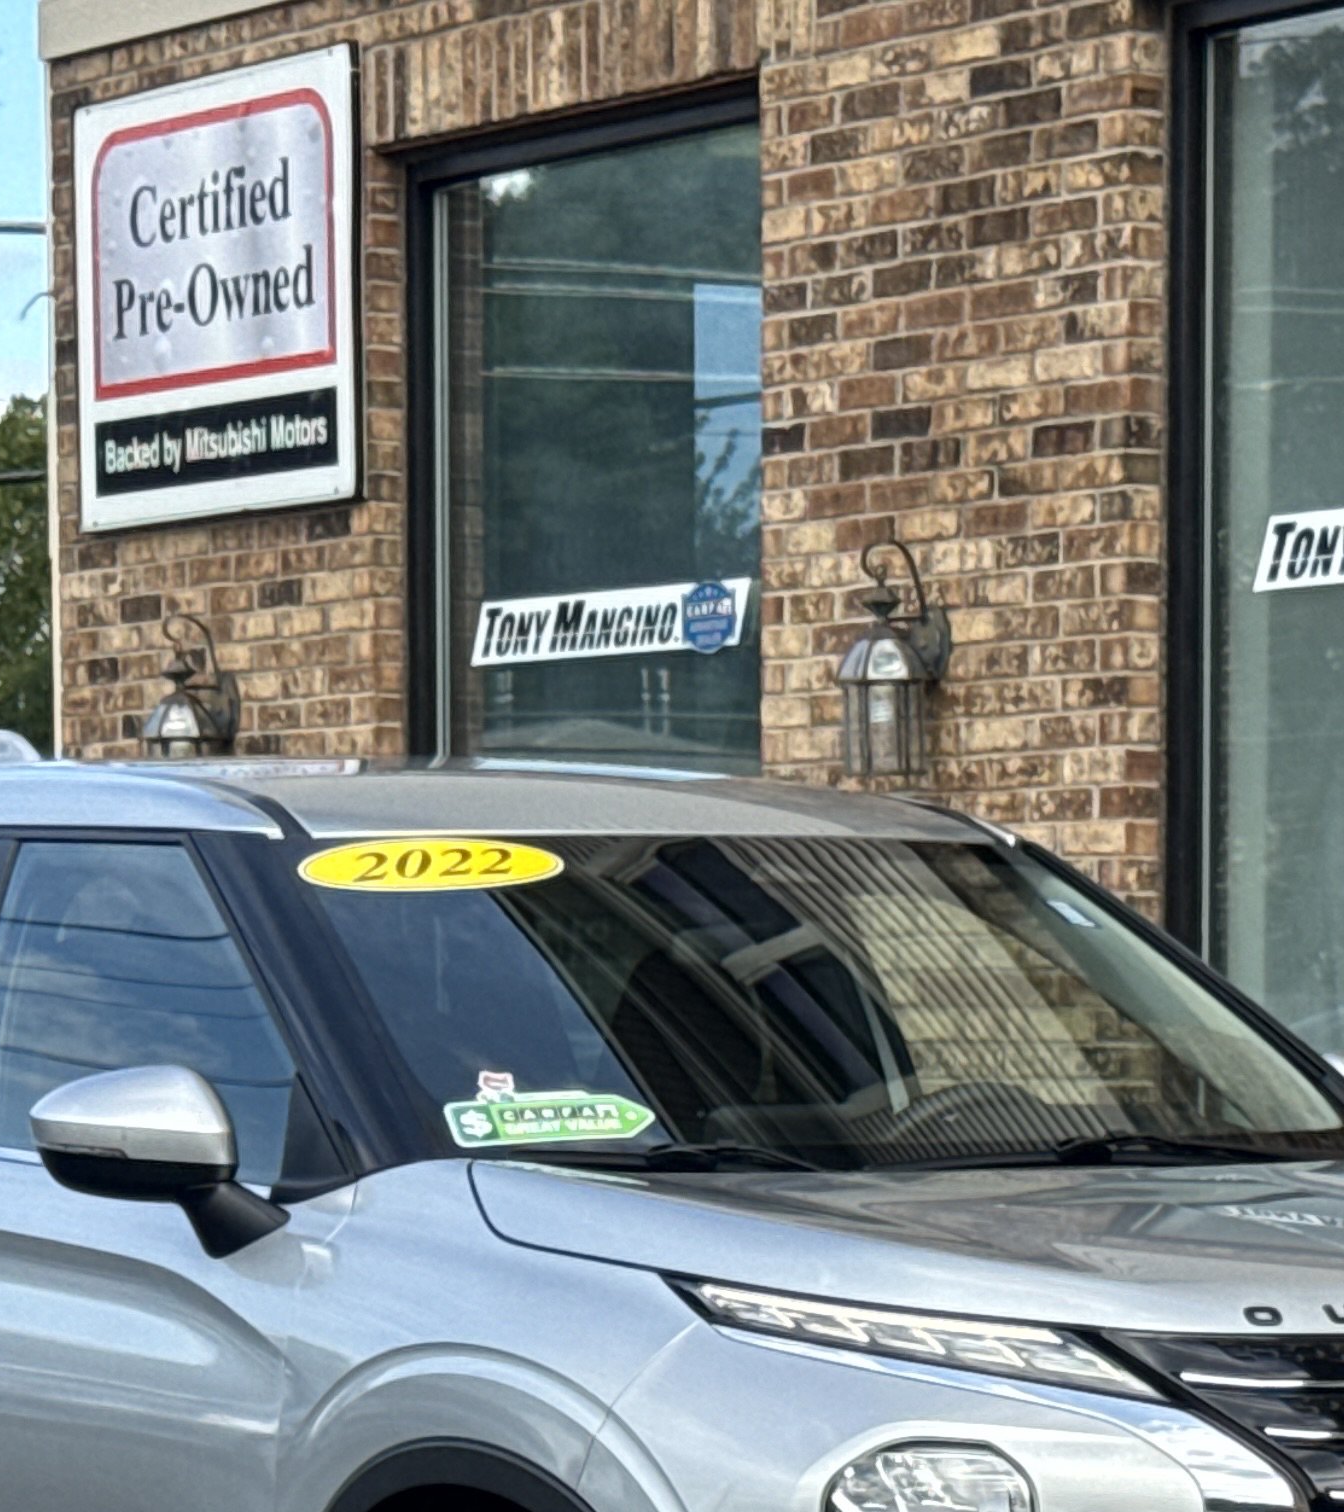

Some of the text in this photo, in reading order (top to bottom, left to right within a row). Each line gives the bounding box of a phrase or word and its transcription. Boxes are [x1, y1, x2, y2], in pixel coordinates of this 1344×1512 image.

[129, 155, 292, 248] Certified
[113, 243, 316, 341] Pre-Owned
[104, 412, 328, 475] Backed by Mitsubishi Motors
[481, 606, 551, 659] TONY
[548, 599, 678, 654] MANGINO
[351, 847, 513, 882] 2022
[502, 1103, 621, 1123] CARFAX
